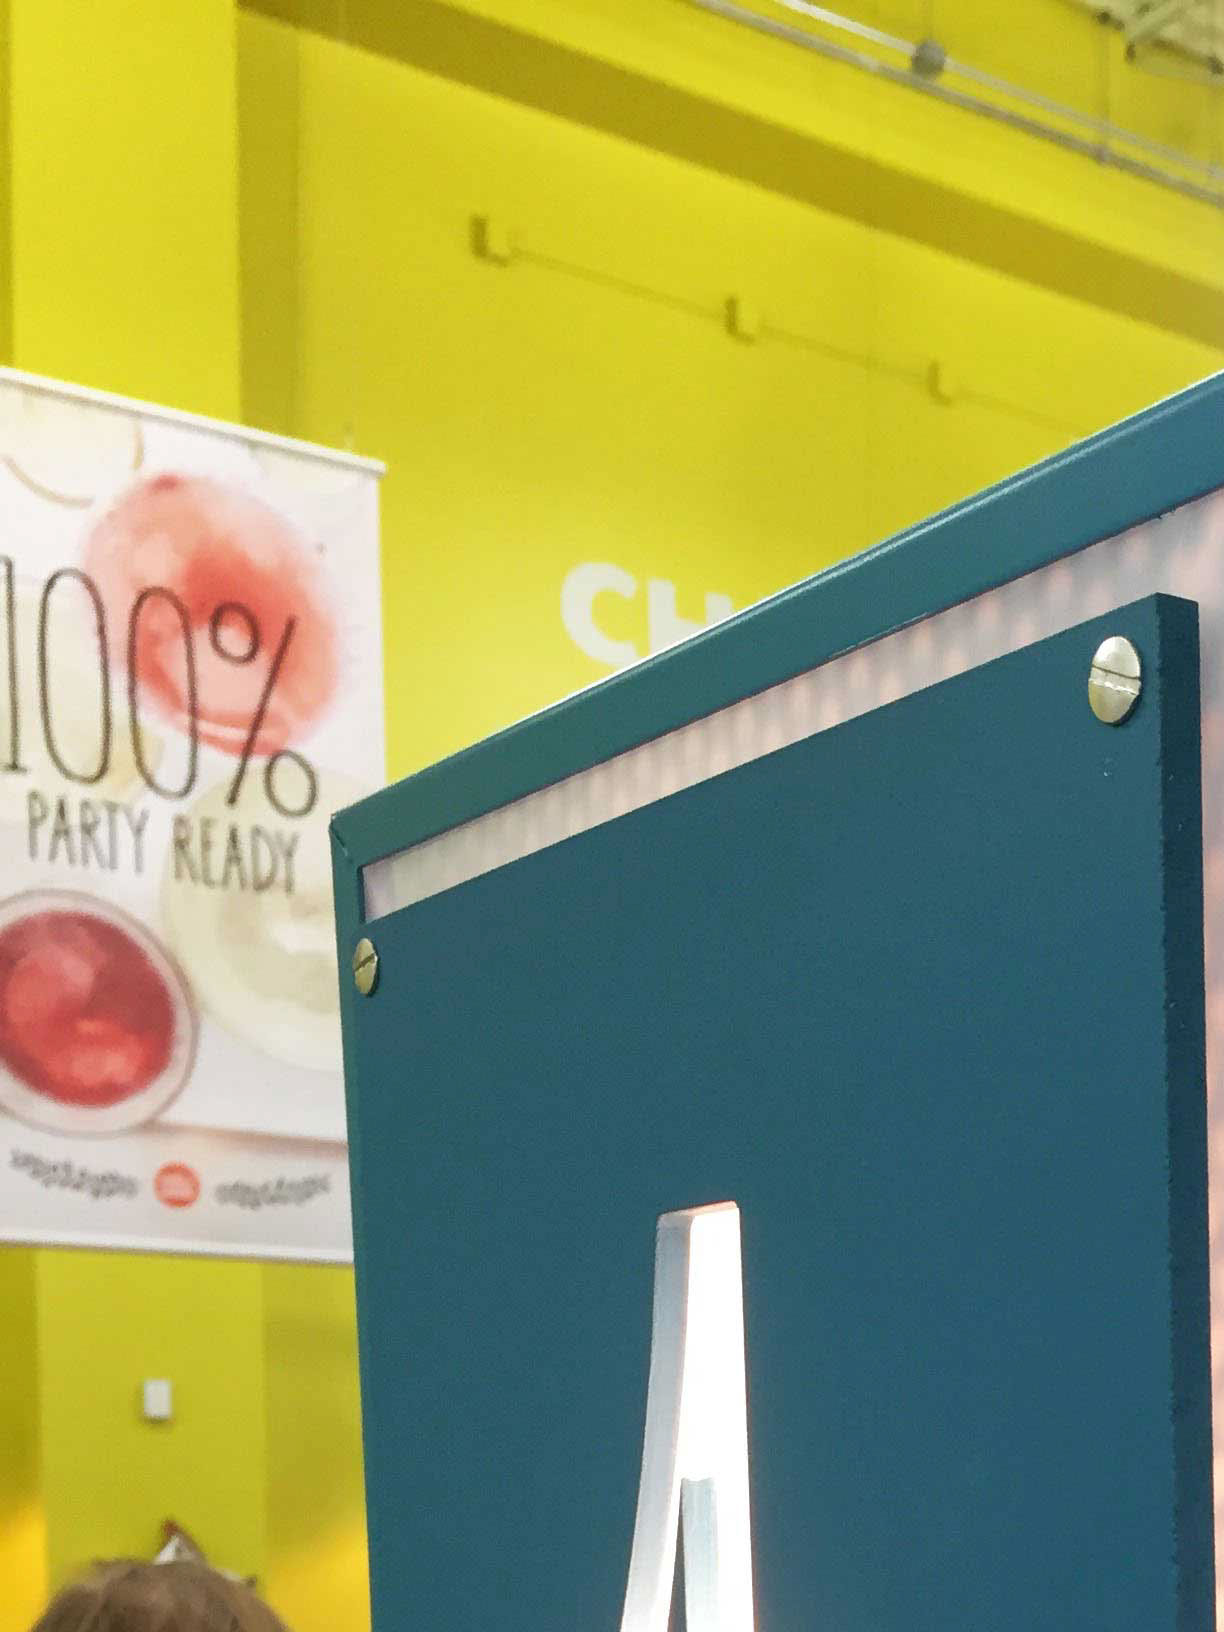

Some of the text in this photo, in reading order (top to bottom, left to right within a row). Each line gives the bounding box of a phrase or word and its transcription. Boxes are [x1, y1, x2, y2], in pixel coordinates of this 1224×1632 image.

[0, 554, 318, 818] 100%
[26, 788, 301, 894] PARTY READY
